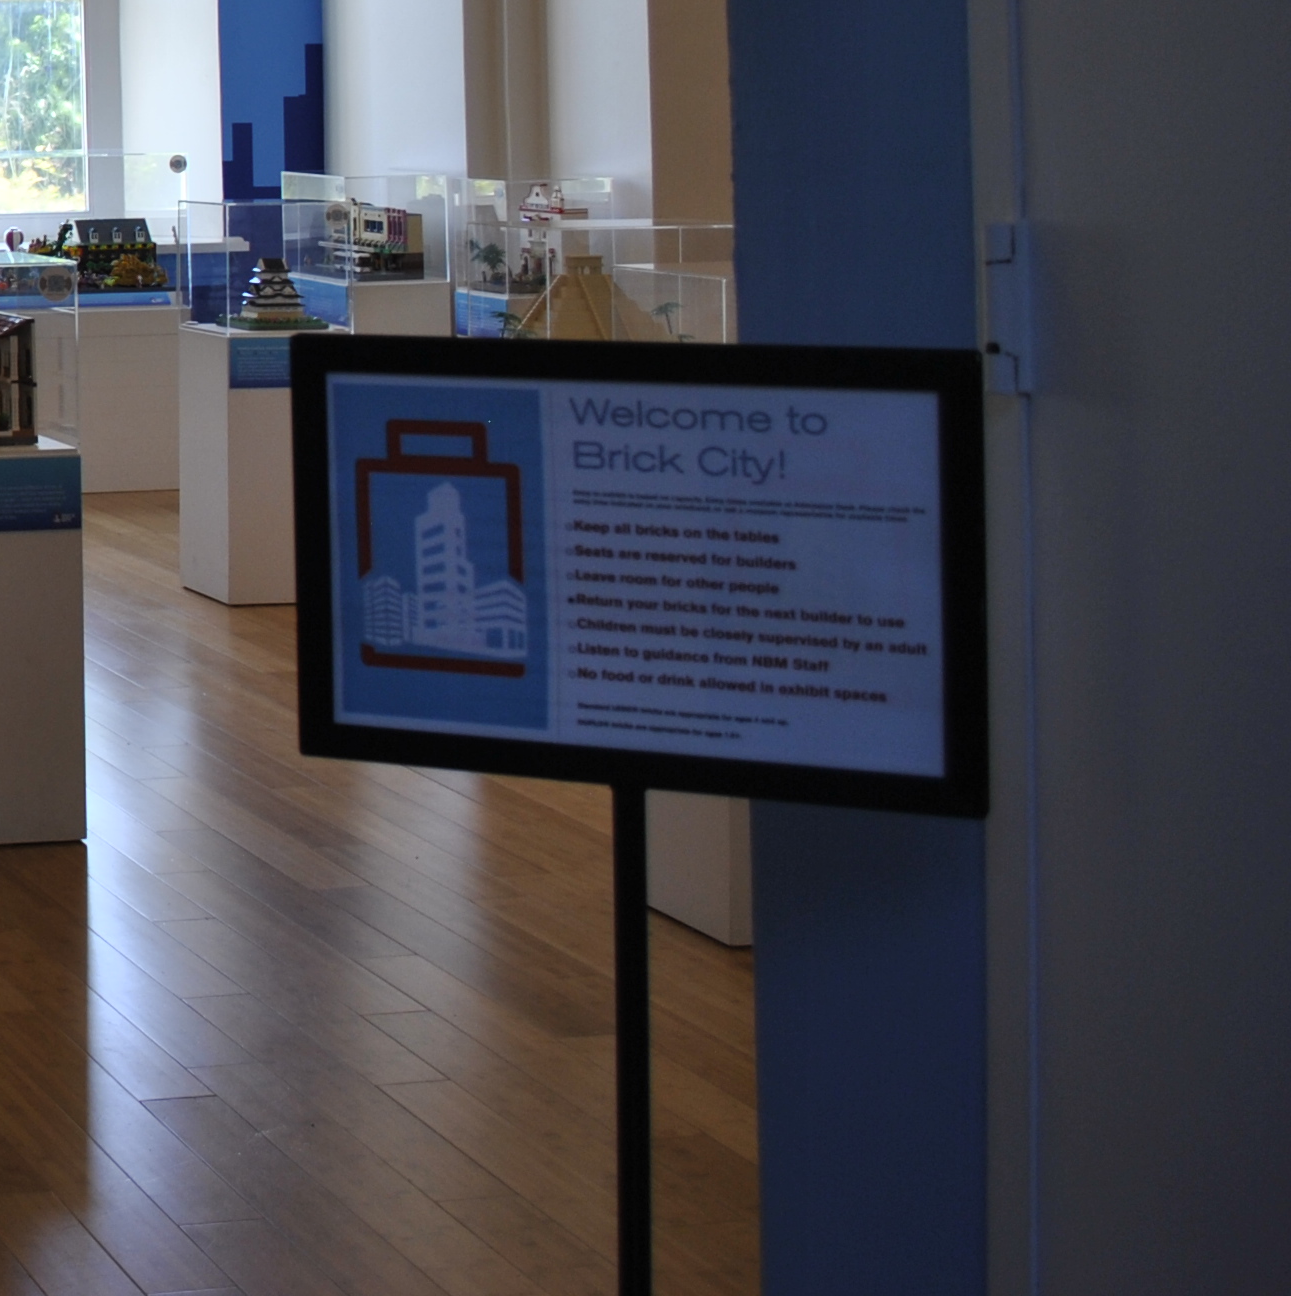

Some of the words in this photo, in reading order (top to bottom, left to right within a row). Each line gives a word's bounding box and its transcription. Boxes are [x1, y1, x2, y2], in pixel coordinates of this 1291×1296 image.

[570, 397, 771, 433] Welcome
[787, 405, 828, 435] to
[573, 440, 684, 474] Brick
[698, 446, 786, 485] City!
[573, 520, 610, 535] Keep
[615, 523, 631, 535] all
[636, 524, 679, 538] bricks
[683, 529, 702, 539] on
[707, 527, 729, 541] the
[734, 529, 780, 544] tables
[574, 544, 614, 559] Seats
[619, 549, 641, 560] are
[645, 550, 707, 565] reserved
[711, 553, 731, 566] for
[736, 555, 797, 571] builders
[574, 568, 616, 583] Leave
[620, 573, 657, 586] room
[661, 574, 682, 587] for
[686, 577, 724, 591] other
[729, 580, 780, 595] people
[576, 593, 622, 607] Return
[627, 600, 658, 612] your
[663, 600, 707, 614] bricks
[711, 603, 731, 616] for
[736, 605, 760, 618] the
[764, 608, 796, 620] next
[800, 609, 852, 624] builder
[857, 613, 873, 627] to
[877, 617, 905, 629] use
[577, 617, 636, 633] Children
[641, 623, 676, 636] must
[680, 625, 698, 638] be
[703, 628, 754, 644] closely
[758, 632, 838, 649] supervised
[843, 638, 861, 652] by
[865, 641, 883, 652] an
[888, 642, 927, 655] adult
[577, 642, 619, 656] Listen
[624, 646, 639, 658] to
[643, 648, 709, 664] guidance
[713, 652, 747, 666] from
[752, 655, 788, 669] NBM
[793, 658, 829, 672] Staff
[577, 667, 597, 680] No
[602, 669, 634, 683] food
[638, 673, 653, 684] or
[657, 674, 695, 688] drink
[699, 677, 756, 693] allowed
[760, 681, 774, 694] in
[779, 684, 830, 698] exhibit
[834, 687, 887, 702] spaces
